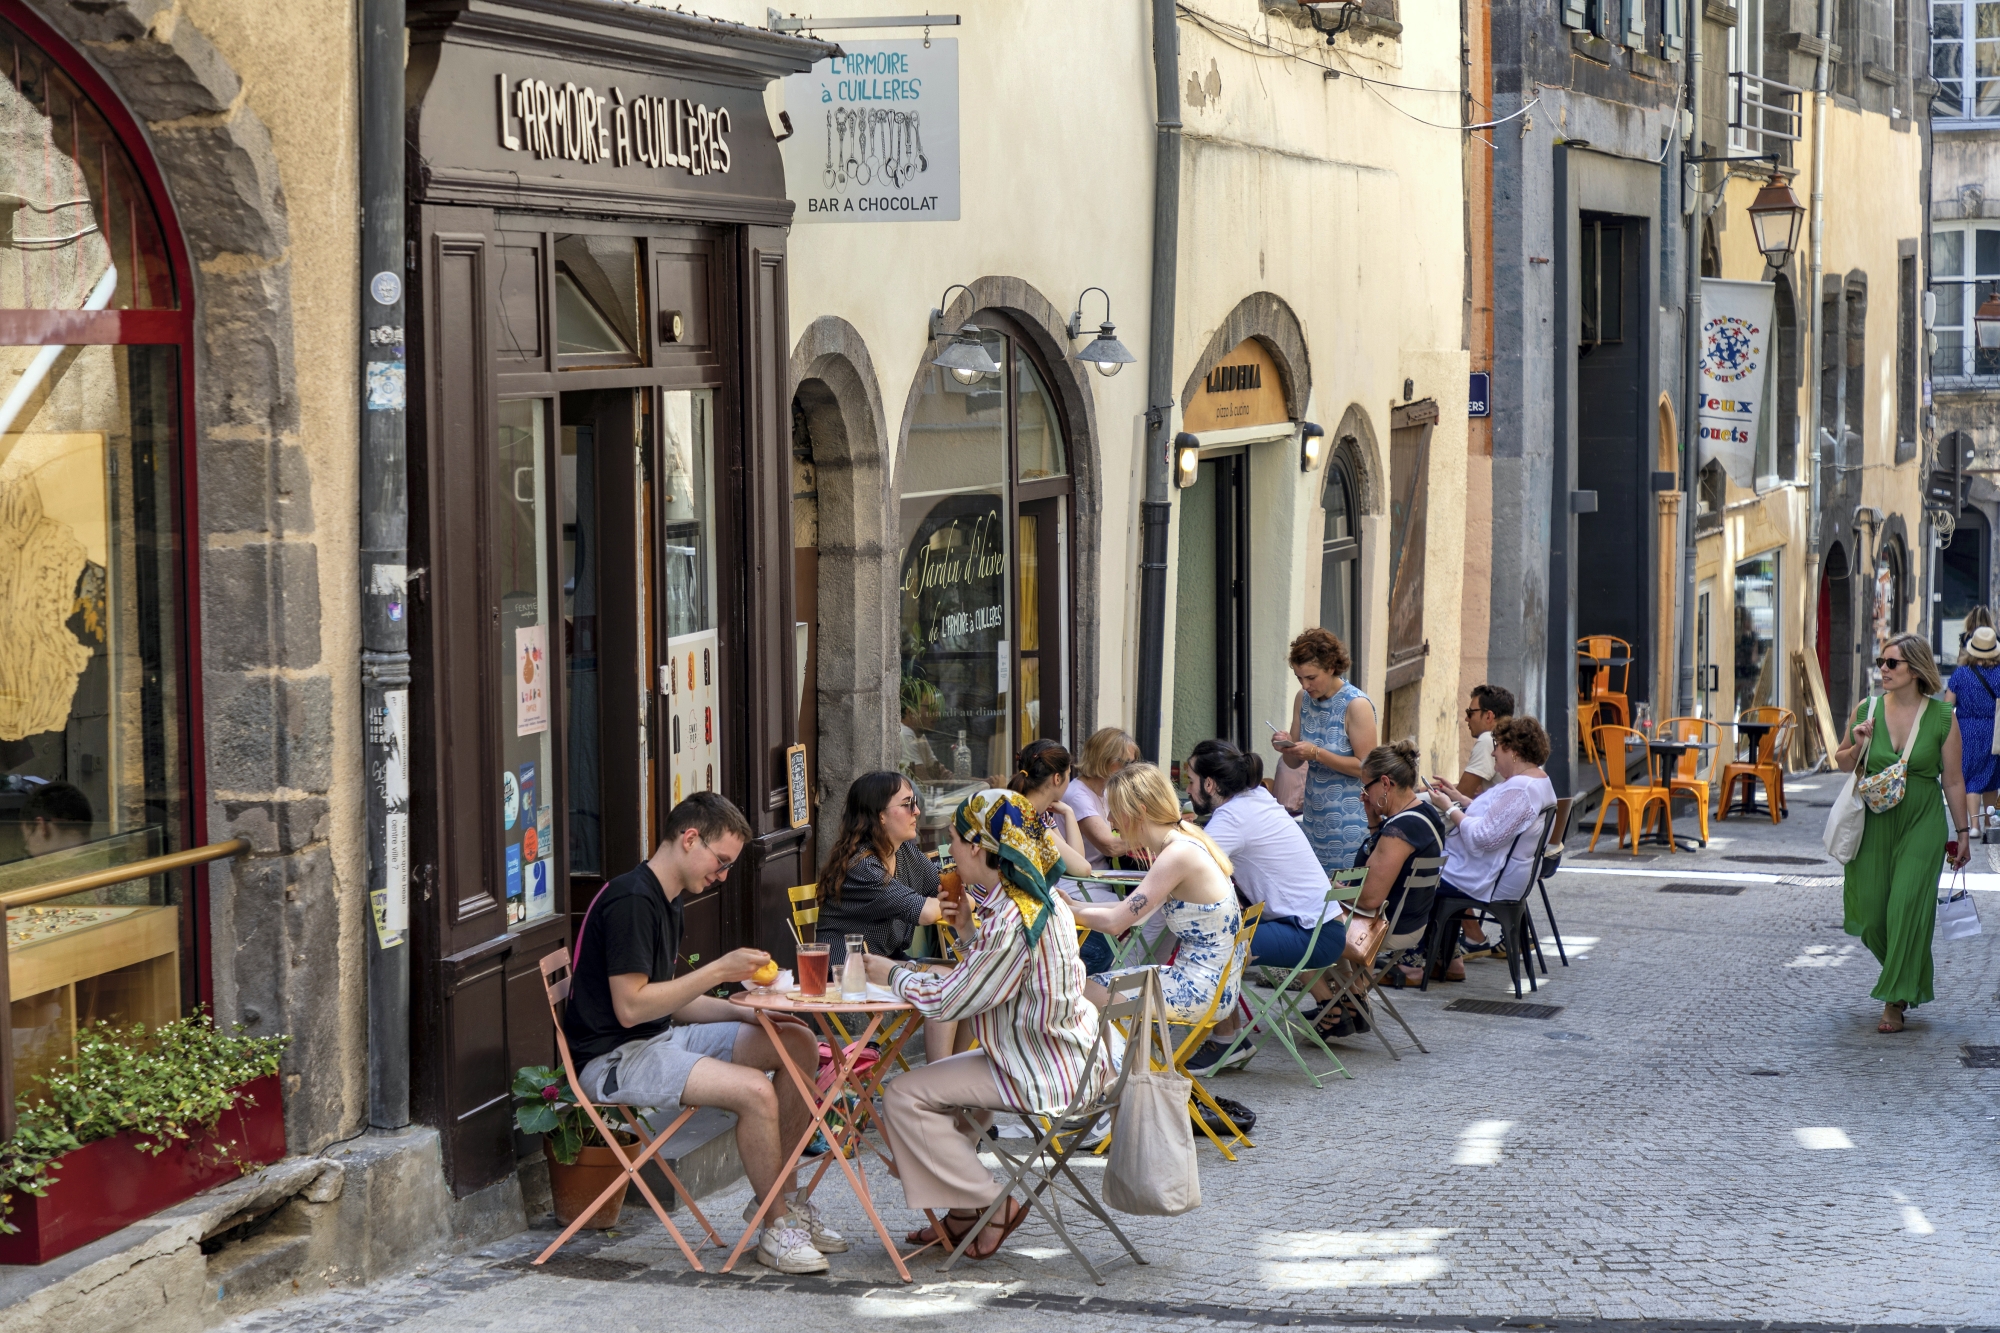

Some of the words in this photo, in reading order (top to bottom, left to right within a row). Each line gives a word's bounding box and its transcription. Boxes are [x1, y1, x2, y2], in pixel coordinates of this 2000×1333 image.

[831, 52, 909, 76] L'ARMOIRE
[821, 83, 833, 103] à
[838, 78, 922, 102] CUILLERES
[499, 73, 610, 165] L'ARMOIRE
[613, 87, 631, 168] À
[634, 94, 732, 176] CUILLÈRES
[808, 199, 840, 213] BAR
[843, 198, 855, 212] A
[858, 196, 939, 212] CHOCOLAT
[1704, 315, 1760, 336] Objectif
[1699, 358, 1757, 383] Découverte
[1216, 403, 1230, 421] pizza
[1699, 426, 1748, 443] ouets
[912, 519, 963, 600] Jardin
[964, 509, 1007, 585] d'hiver
[928, 601, 940, 644] de
[960, 708, 973, 717] au
[391, 819, 399, 845] centre
[391, 846, 399, 863] ville
